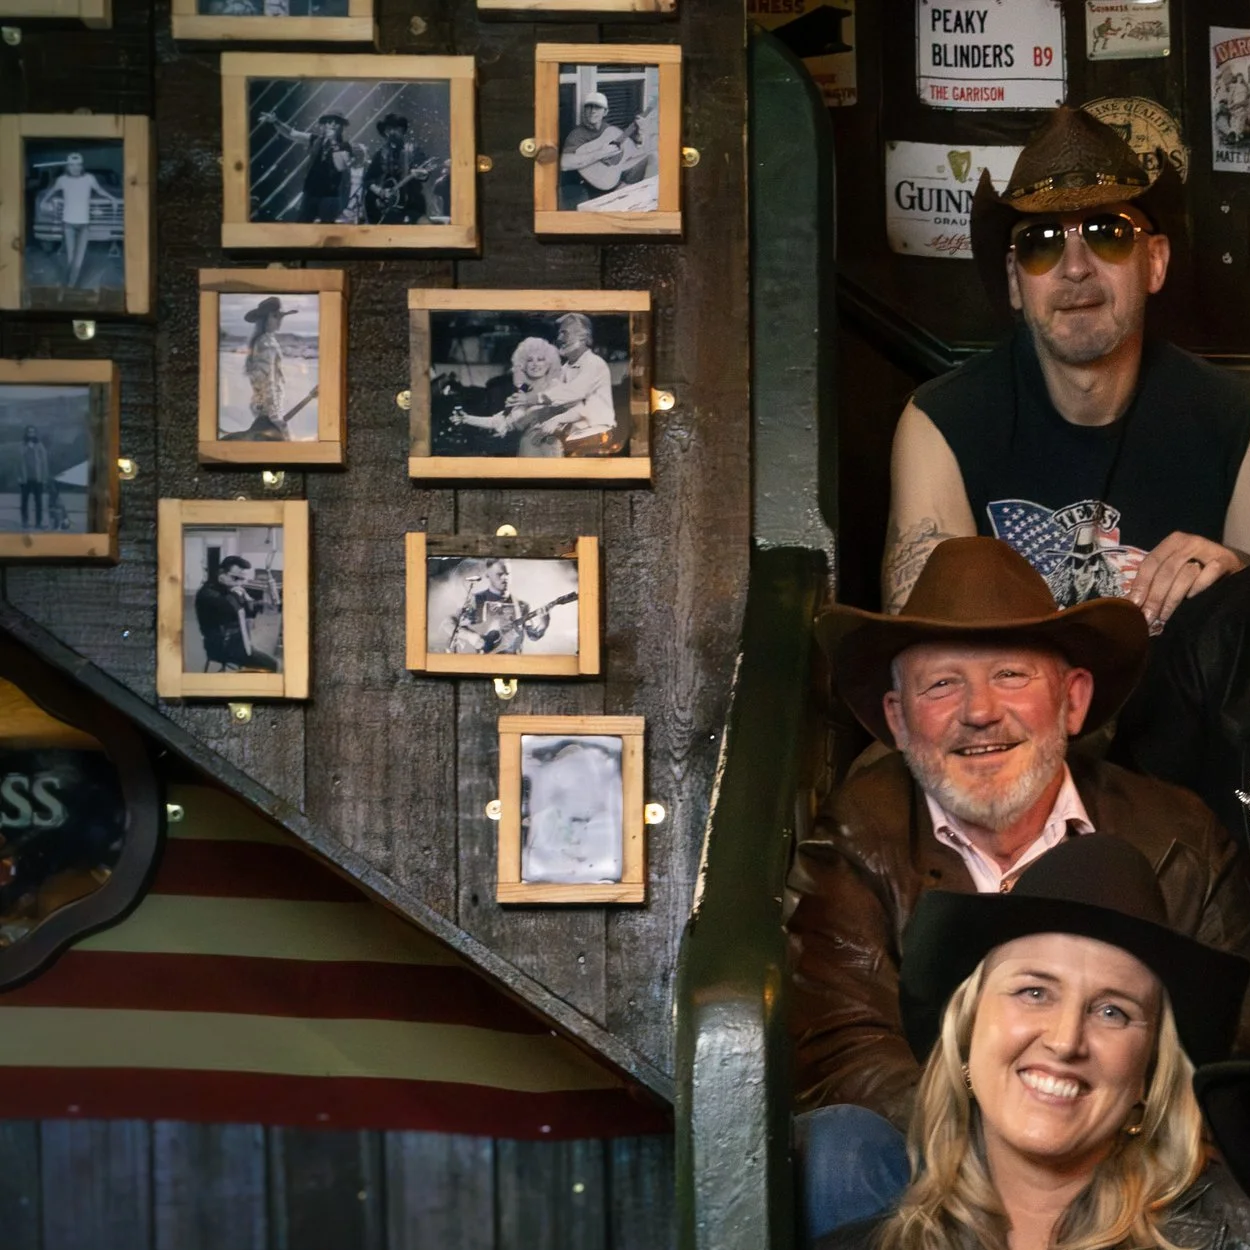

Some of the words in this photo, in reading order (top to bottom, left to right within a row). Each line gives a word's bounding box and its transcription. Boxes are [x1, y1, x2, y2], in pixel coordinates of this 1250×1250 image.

[931, 8, 988, 34] PEAKY
[932, 43, 1014, 68] BLINDERS
[1033, 46, 1053, 67] B9
[930, 84, 949, 100] THE
[952, 86, 1004, 102] GARRISON
[934, 217, 971, 226] DRAU
[1054, 502, 1115, 530] TEXAS
